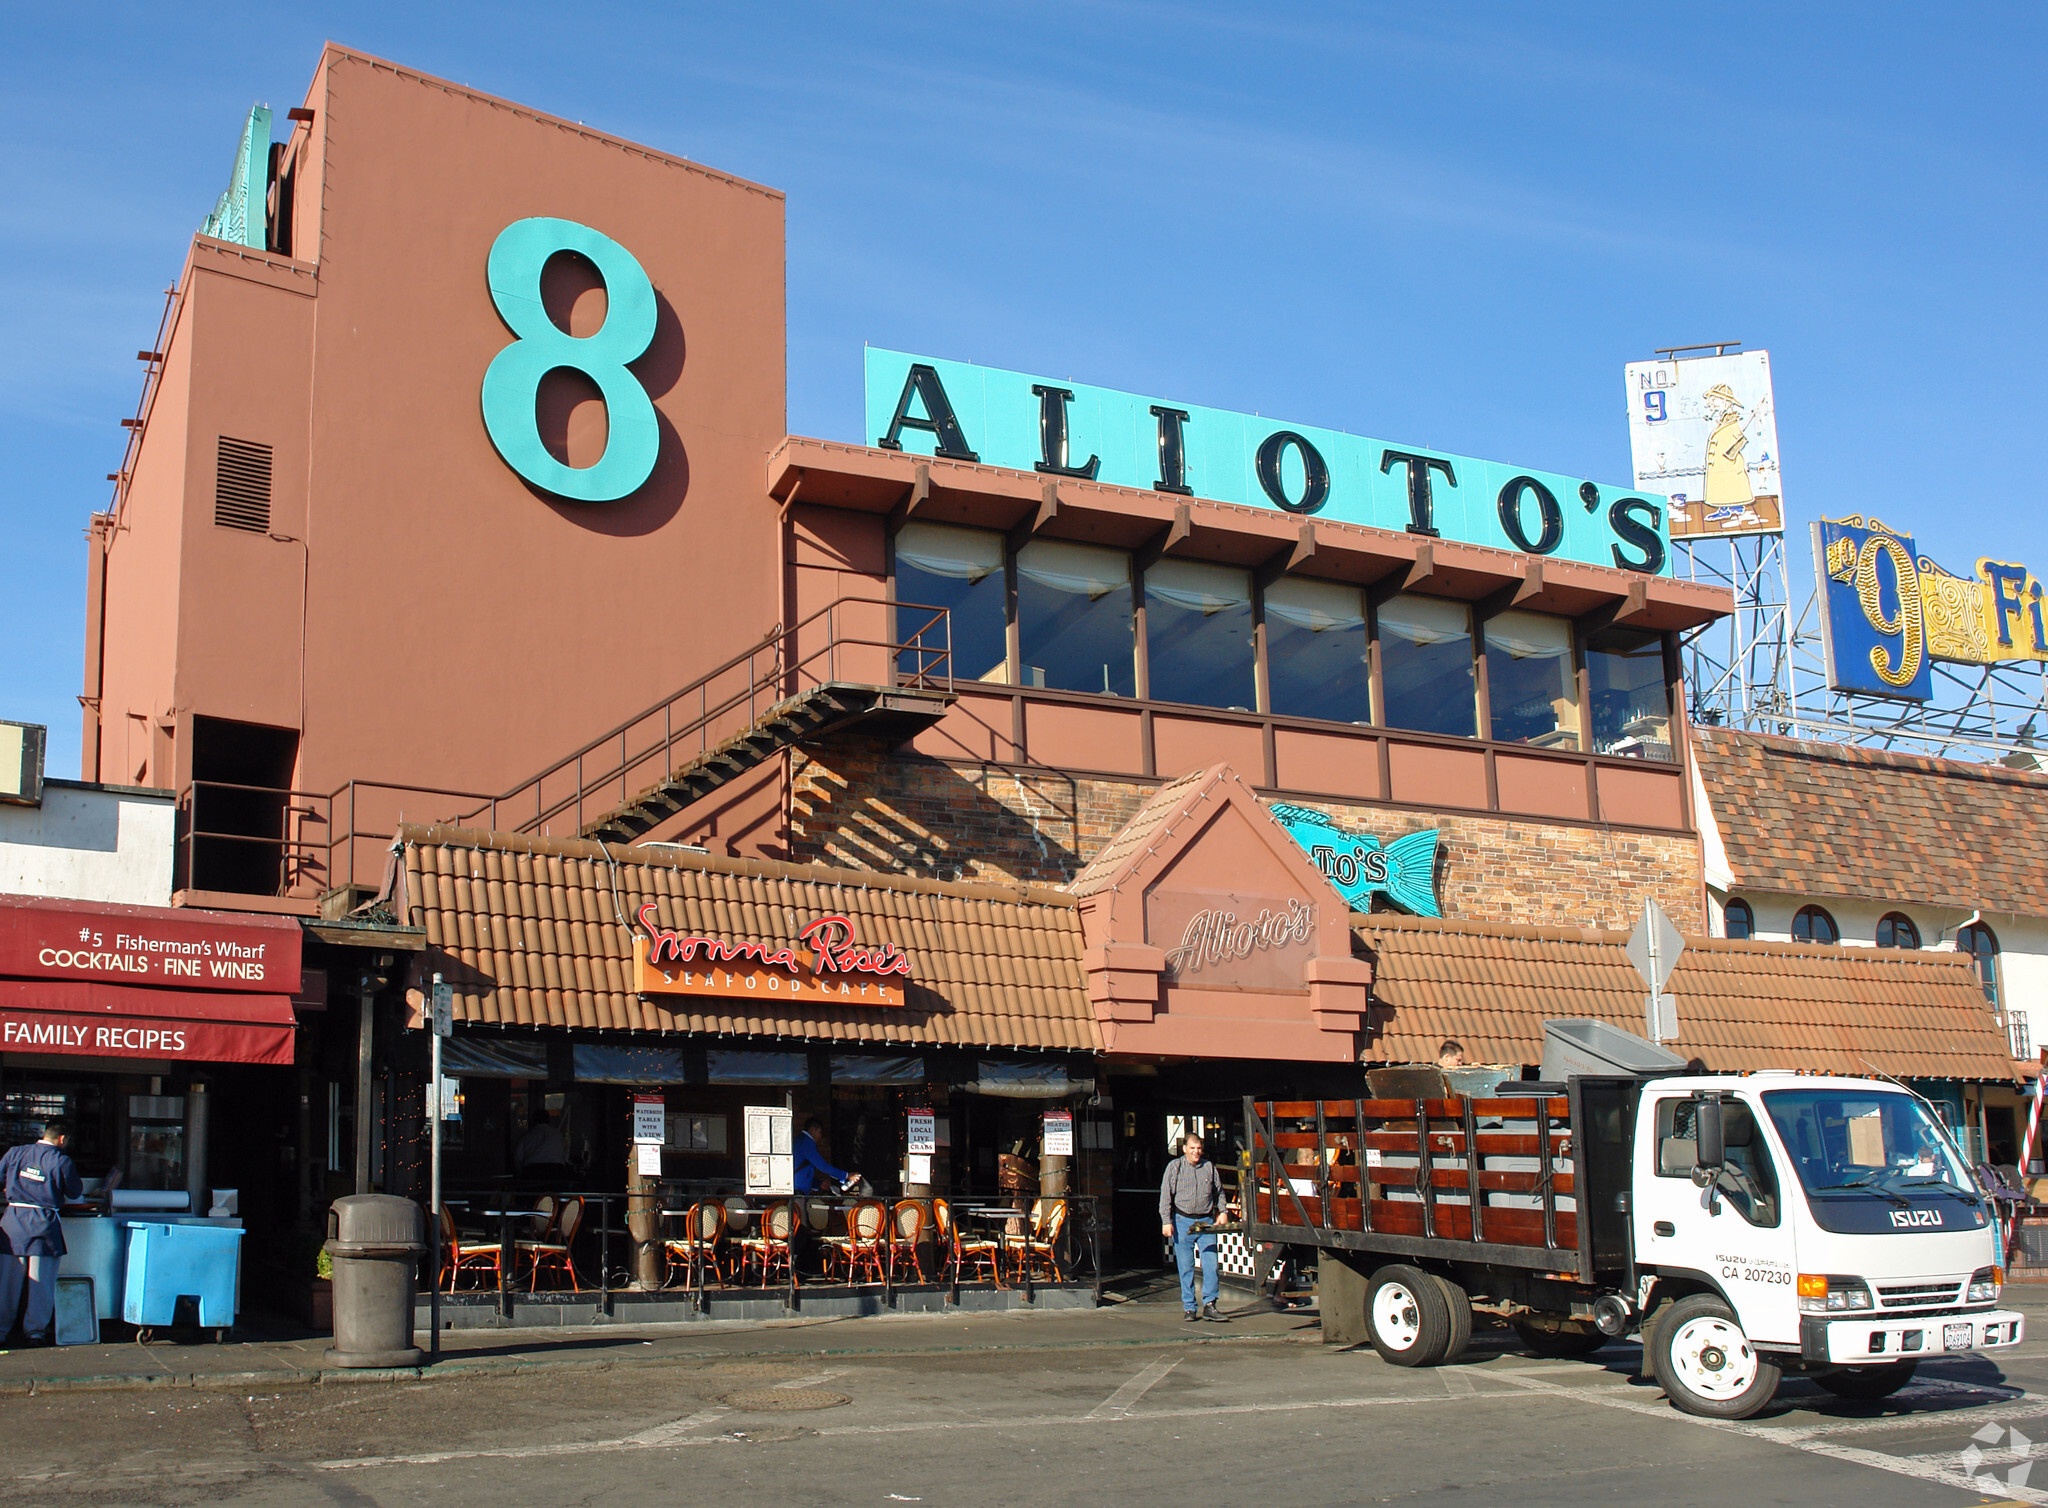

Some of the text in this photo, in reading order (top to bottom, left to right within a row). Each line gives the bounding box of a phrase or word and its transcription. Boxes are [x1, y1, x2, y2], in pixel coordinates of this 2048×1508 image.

[480, 216, 660, 502] 8
[1643, 391, 1669, 423] 9
[877, 362, 1665, 575] ALIOTO'S
[1855, 534, 1924, 687] 9
[116, 933, 212, 956] Fisherman's
[216, 941, 266, 960] Wharf
[638, 902, 914, 976] Nonna Rose's
[1164, 897, 1315, 974] Alioto's
[38, 948, 265, 981] COCKTAILS FINE WINES
[663, 970, 887, 998] SEAFOOD CAFE
[3, 1021, 186, 1051] FAMILY RECIPES
[1888, 1209, 1943, 1228] ISUZU
[1715, 1254, 1747, 1264] ISUZU
[1722, 1265, 1792, 1285] CA 207230
